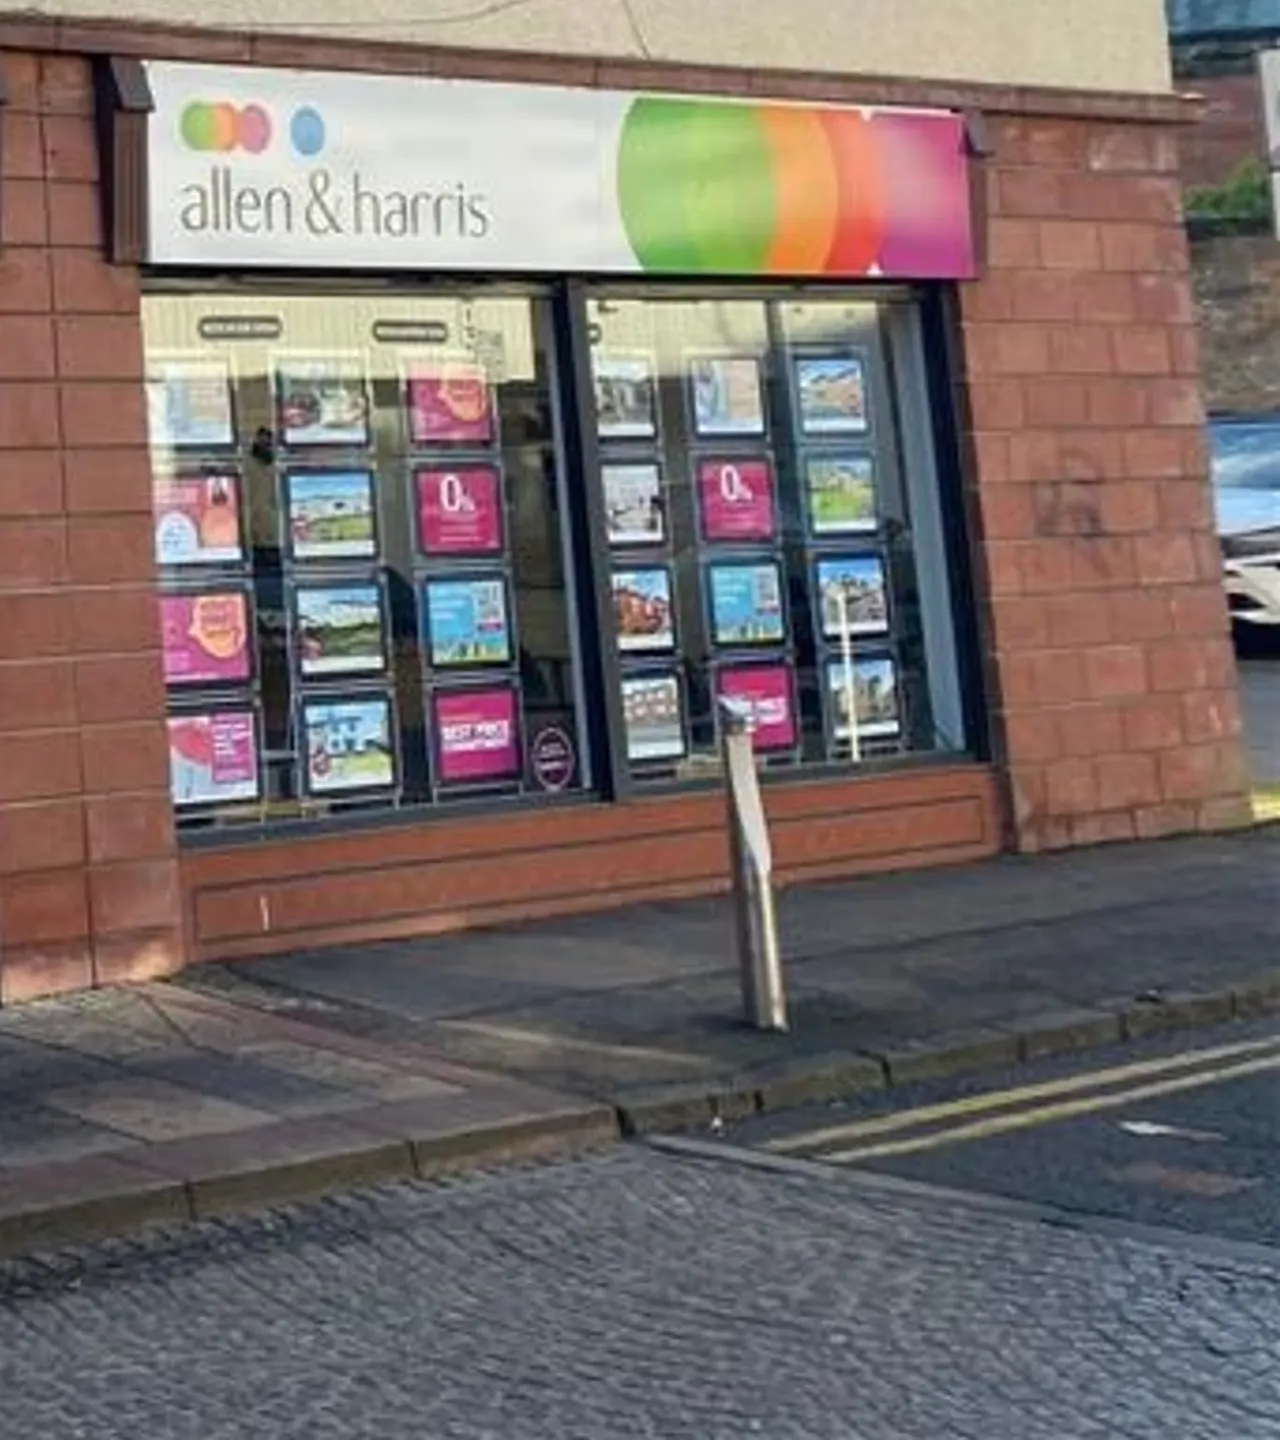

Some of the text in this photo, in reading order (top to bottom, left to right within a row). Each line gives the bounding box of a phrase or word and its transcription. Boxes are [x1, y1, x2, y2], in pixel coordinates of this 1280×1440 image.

[178, 166, 489, 237] allen & harris
